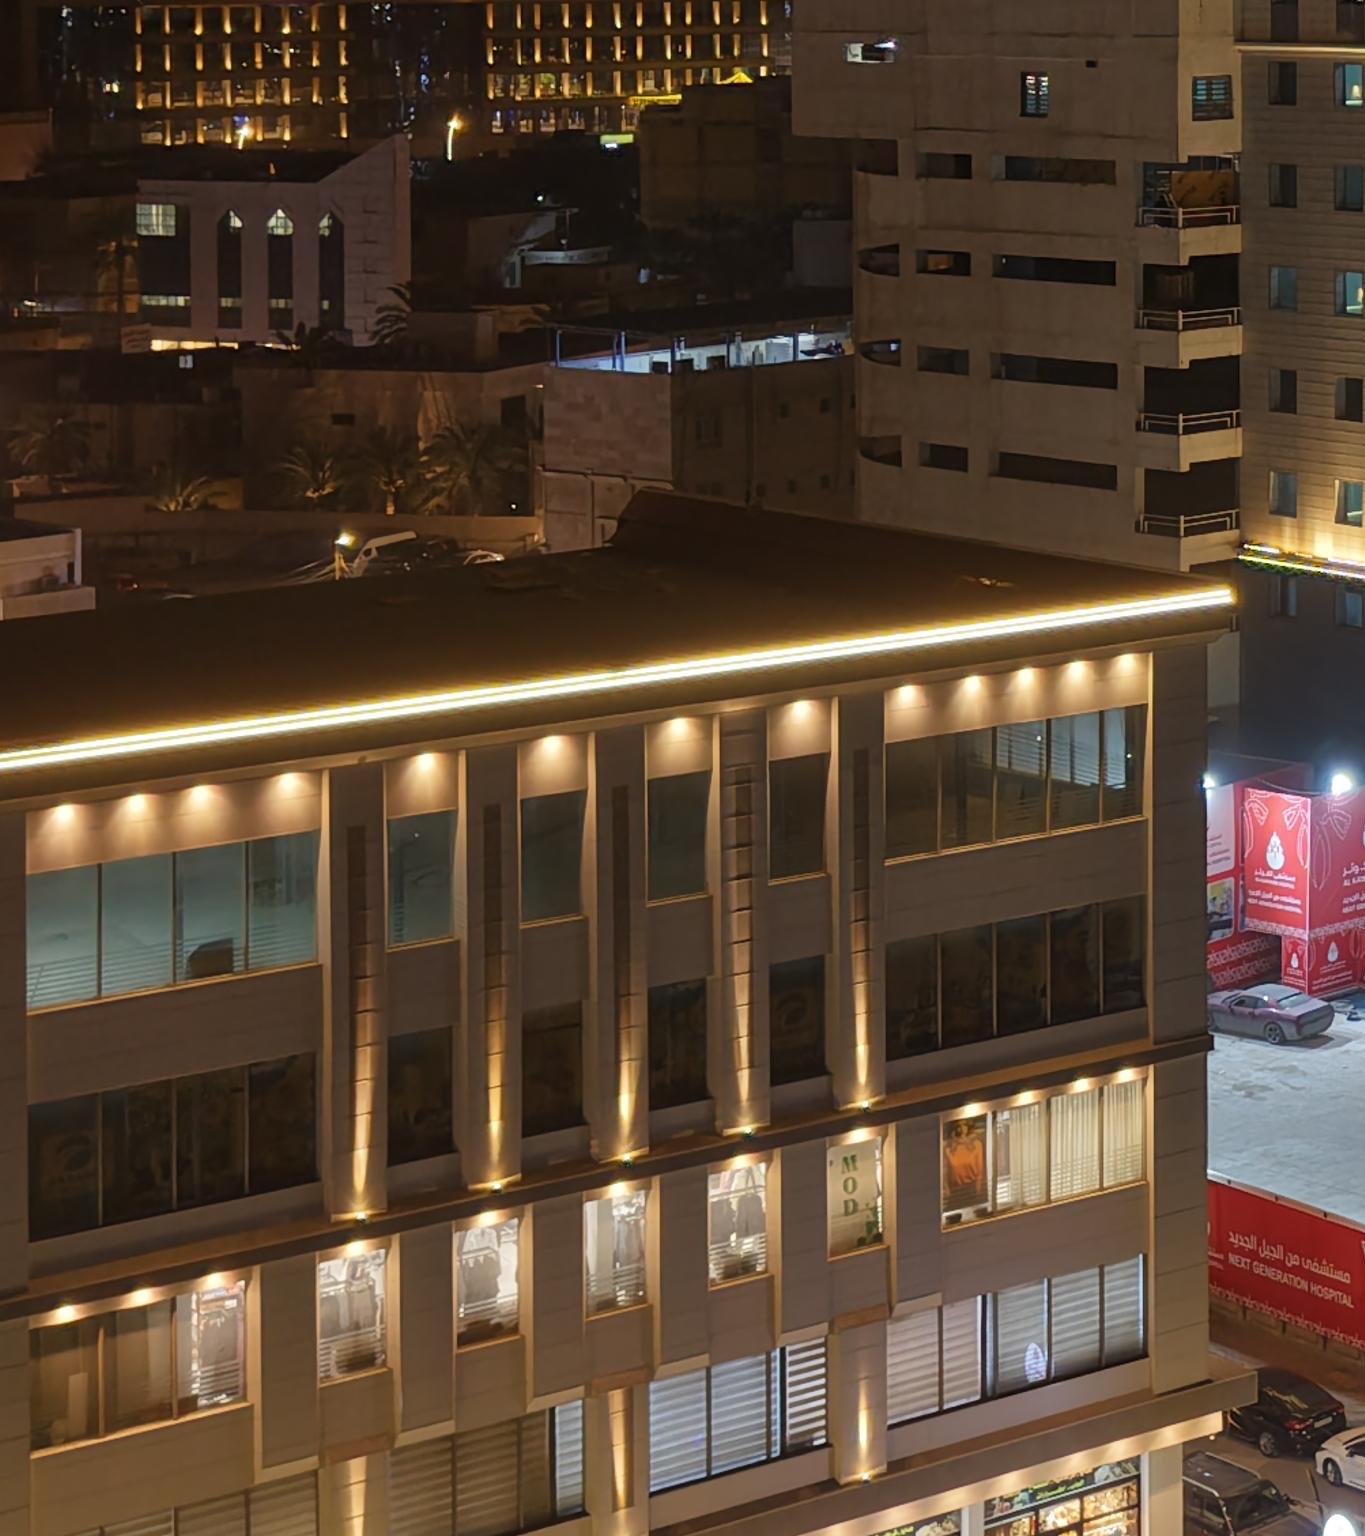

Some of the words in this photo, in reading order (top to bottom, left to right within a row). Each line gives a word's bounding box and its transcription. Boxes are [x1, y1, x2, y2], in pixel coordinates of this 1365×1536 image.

[1228, 1231, 1257, 1252] الجديد
[1258, 1238, 1284, 1261] الجيل
[1285, 1252, 1299, 1267] من
[1301, 1258, 1351, 1284] مستشفى
[1228, 1252, 1252, 1271] NEXT
[1252, 1261, 1309, 1293] GENERATION
[1310, 1281, 1355, 1309] HOSPITAL
